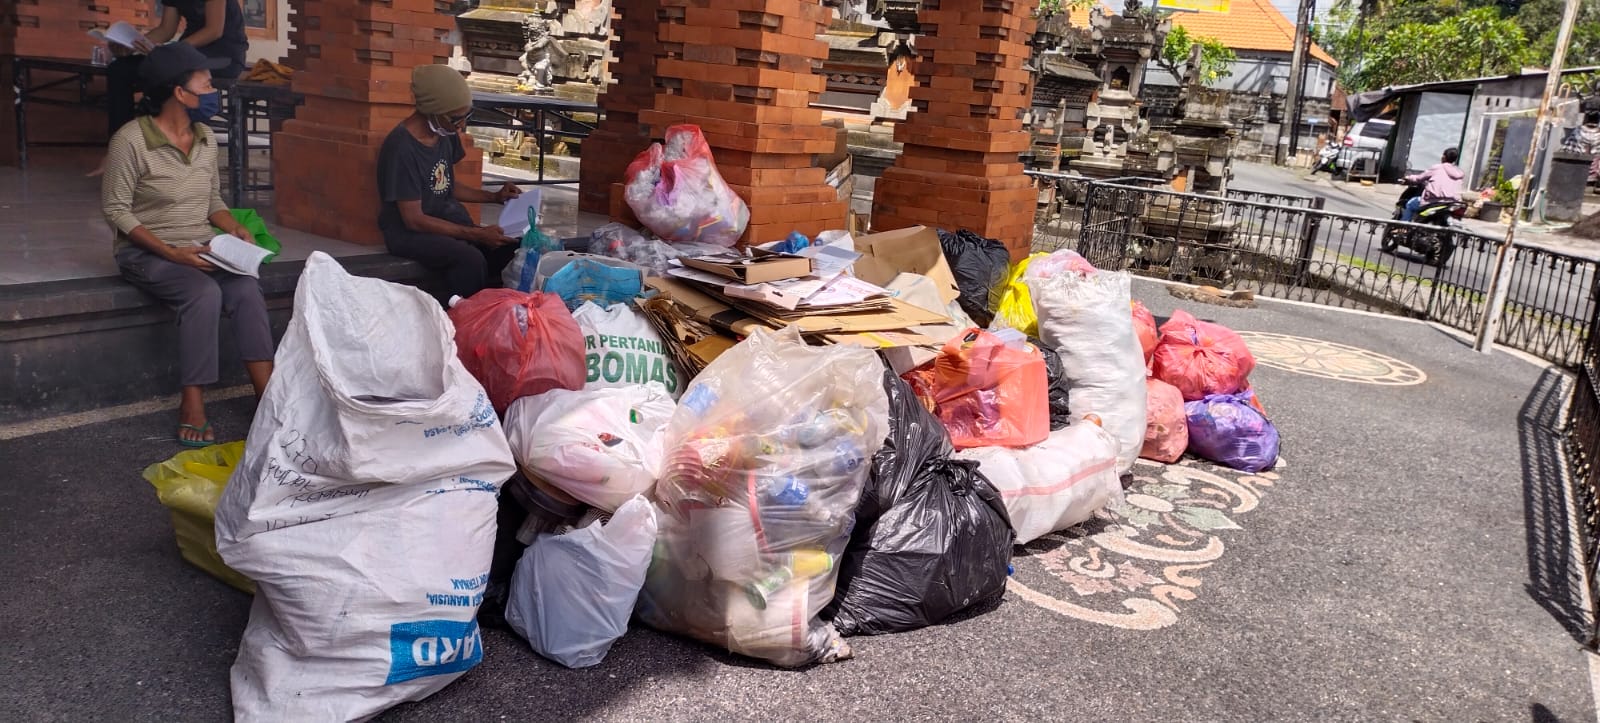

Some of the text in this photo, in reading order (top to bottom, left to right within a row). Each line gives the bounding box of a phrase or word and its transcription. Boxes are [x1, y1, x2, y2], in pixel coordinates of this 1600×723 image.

[450, 577, 480, 591] TERNAK
[426, 592, 470, 607] MANUSIA,
[411, 630, 483, 668] ARD
